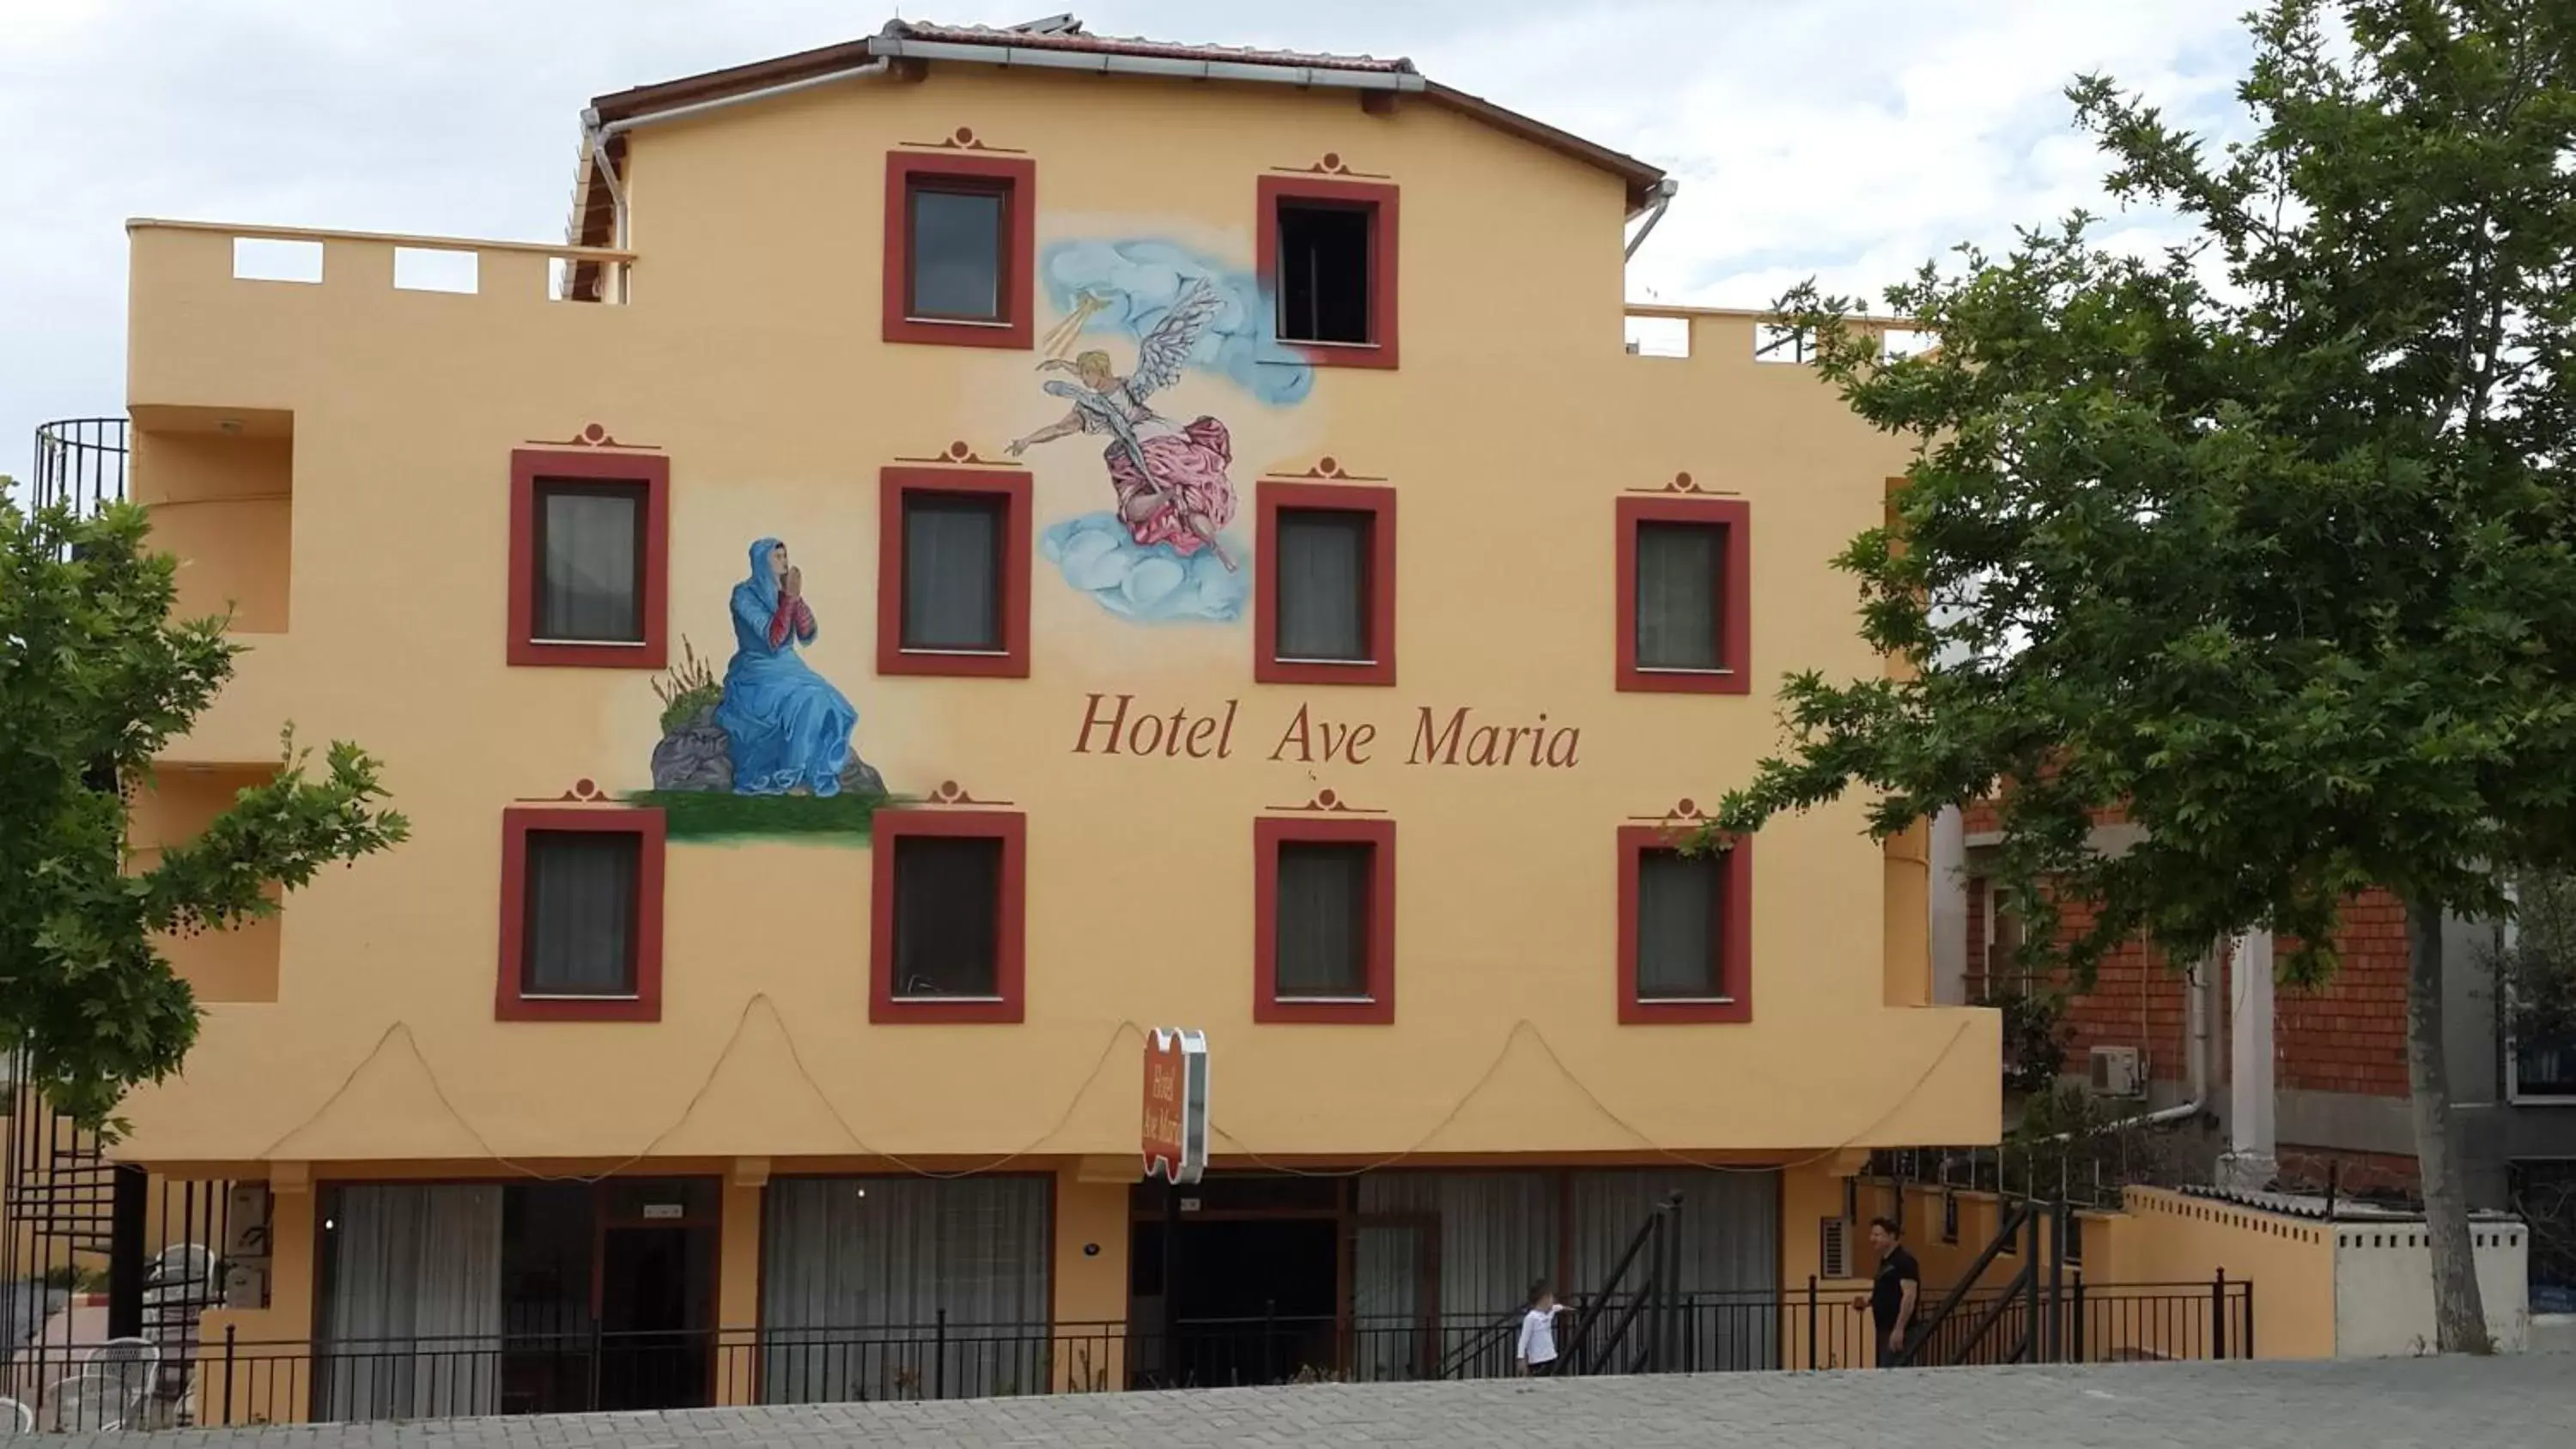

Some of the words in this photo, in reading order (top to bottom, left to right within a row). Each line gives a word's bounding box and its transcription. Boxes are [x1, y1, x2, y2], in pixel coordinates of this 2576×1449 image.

[1072, 693, 1238, 760] Hotel
[1267, 701, 1376, 764] Ave
[1405, 706, 1581, 768] Maria
[1152, 1064, 1176, 1101] Hotel
